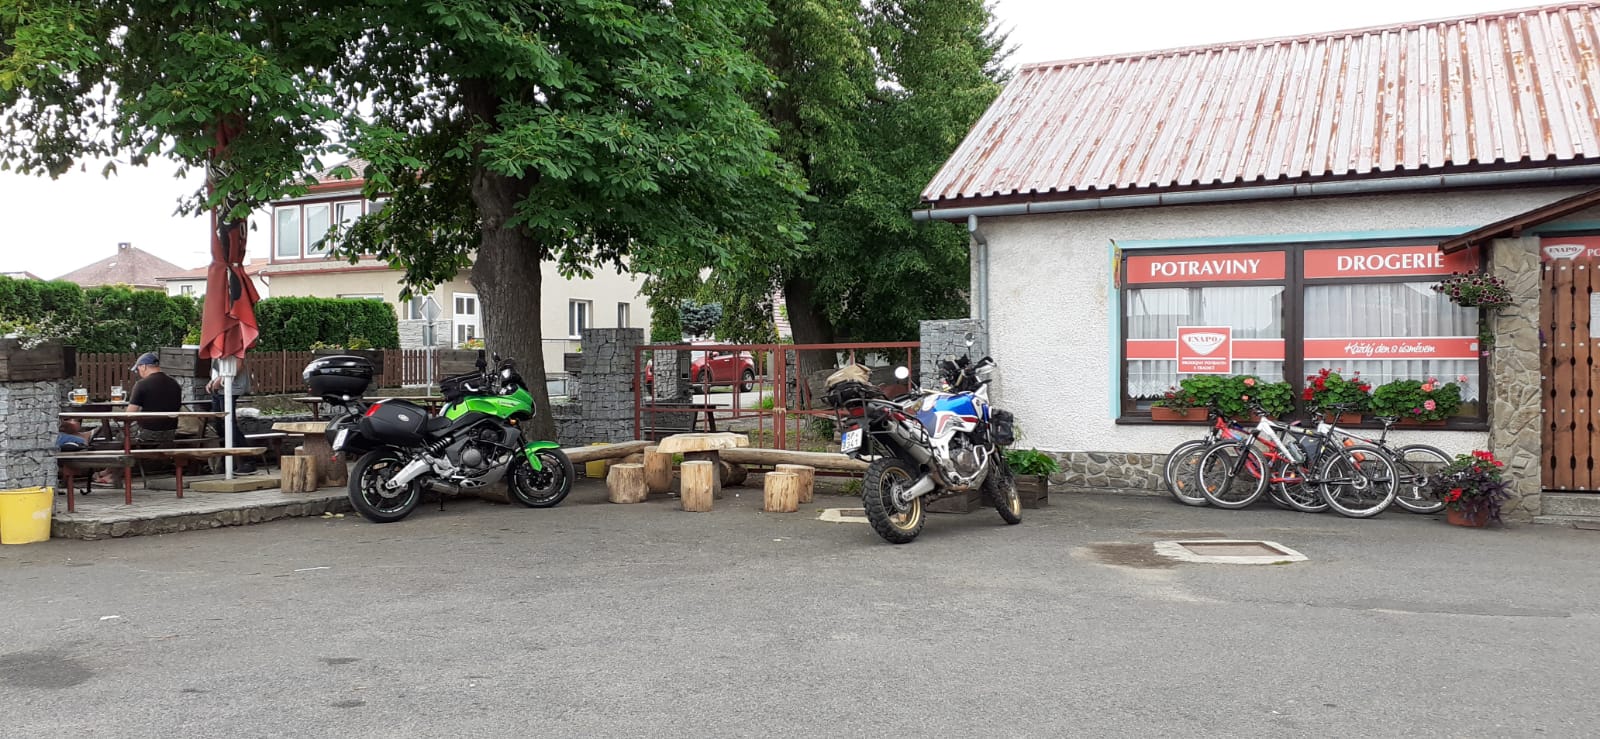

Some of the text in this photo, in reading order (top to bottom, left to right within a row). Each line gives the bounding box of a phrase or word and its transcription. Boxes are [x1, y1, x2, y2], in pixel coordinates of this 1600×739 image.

[1151, 259, 1260, 277] POTRAVINY
[1337, 252, 1445, 271] DROGERIE
[1375, 343, 1390, 353] den
